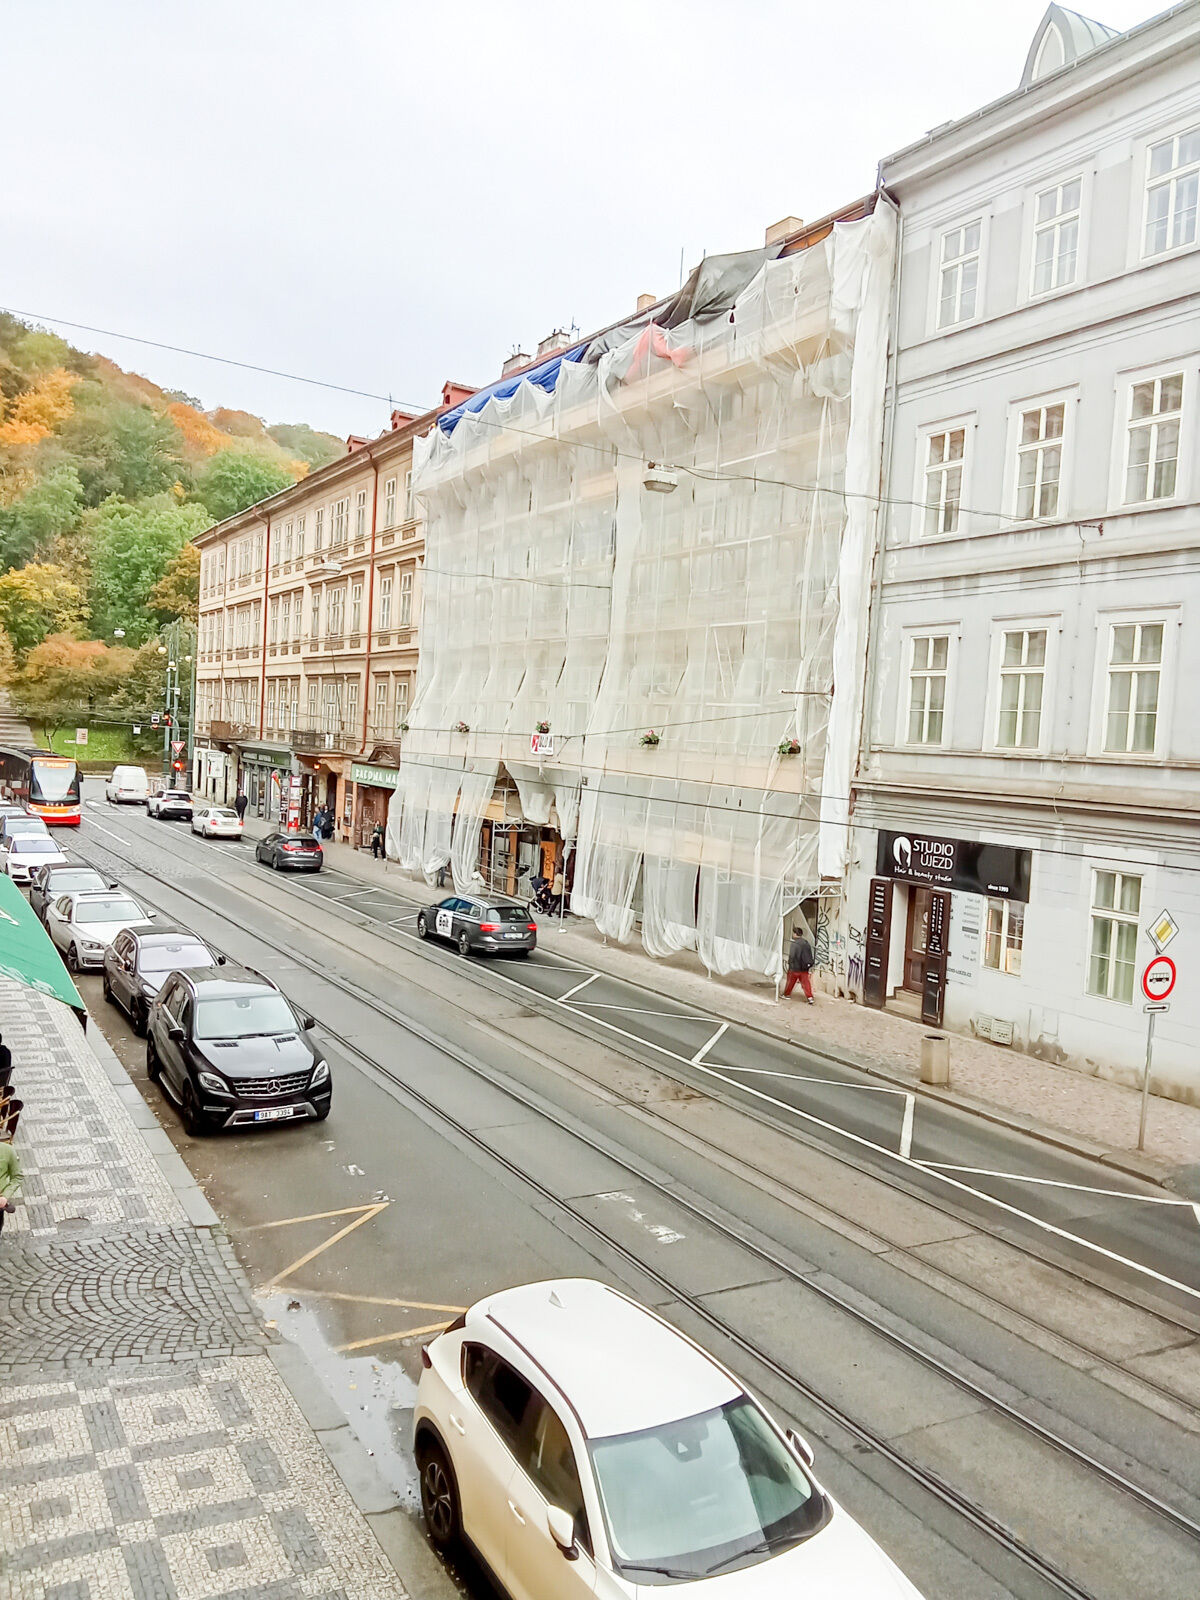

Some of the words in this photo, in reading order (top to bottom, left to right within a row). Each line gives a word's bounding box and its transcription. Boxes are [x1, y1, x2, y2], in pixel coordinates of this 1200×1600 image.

[913, 840, 954, 856] STUDIO
[920, 852, 953, 870] ÚJEZD
[894, 866, 907, 874] Hair
[914, 870, 933, 881] beauty
[934, 874, 952, 882] studio
